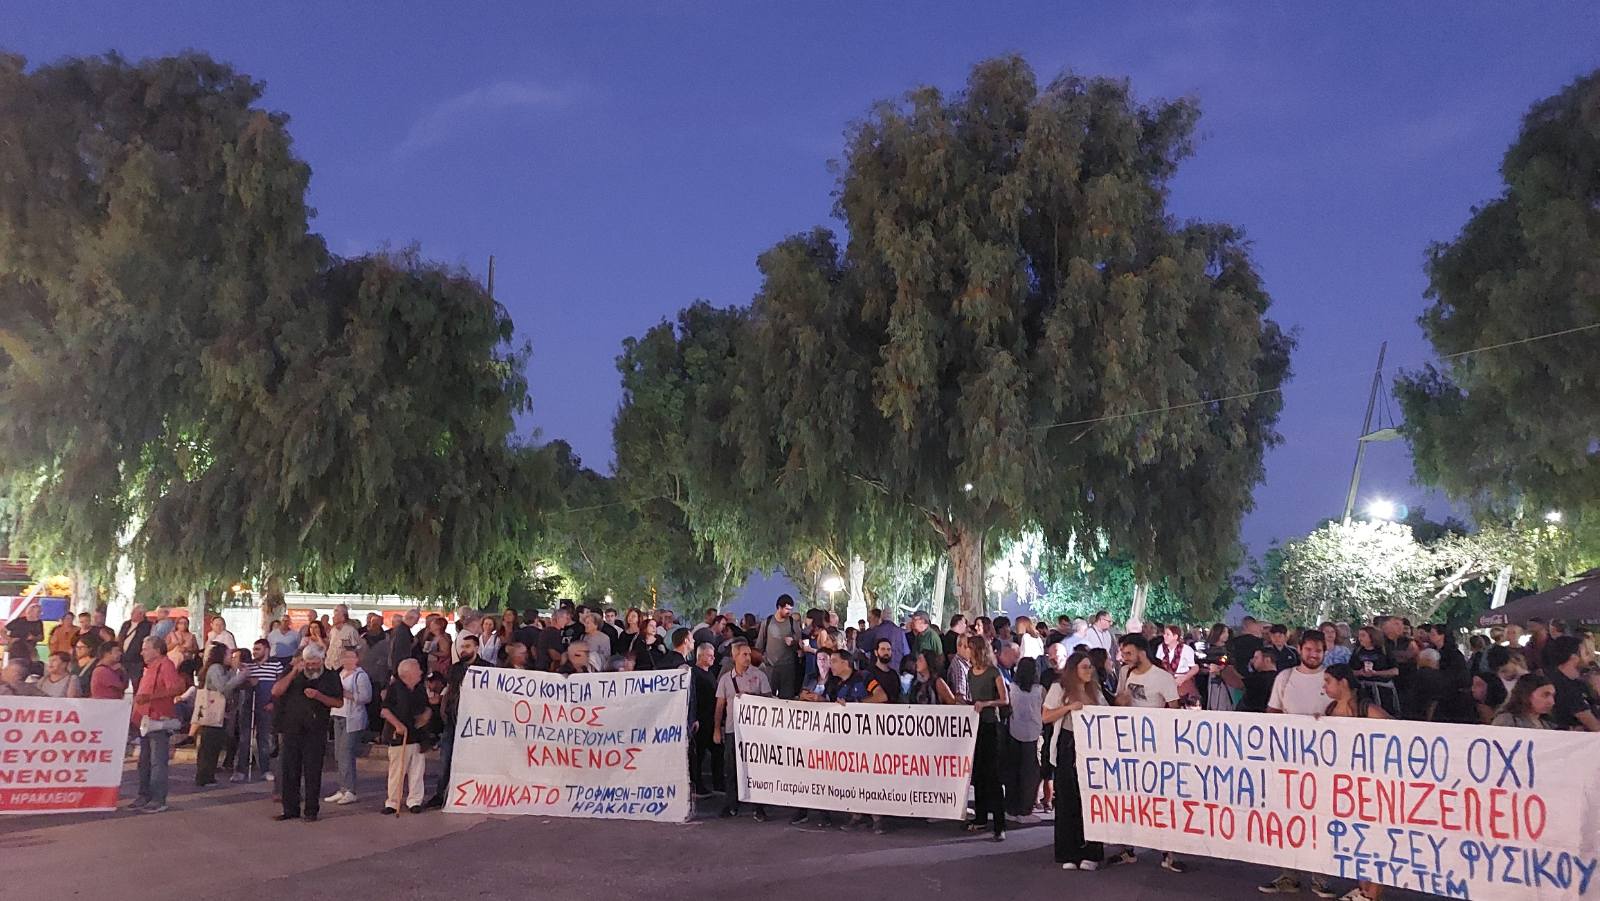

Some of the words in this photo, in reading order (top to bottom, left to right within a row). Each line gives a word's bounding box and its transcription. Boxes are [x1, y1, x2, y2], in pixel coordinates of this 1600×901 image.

[469, 669, 489, 690] ΤΑ
[497, 672, 592, 703] ΝΟΣΟΚΟΜΕΙΑ
[599, 680, 617, 698] ΤΑ
[514, 700, 531, 724] Ο
[542, 703, 606, 726] ΛΑΟΣ
[738, 703, 768, 726] ΚΑΤΩ
[771, 707, 784, 728] ΤΑ
[787, 708, 820, 732] ΧΕΡΙΑ
[823, 711, 851, 734] ΑΠΟ
[855, 714, 872, 735] ΤΑ
[875, 714, 973, 738] ΝΟΣΟΚΟΜΕΙΑ
[4, 729, 23, 743] Ο
[32, 729, 103, 743] ΛΑΟΣ
[460, 716, 497, 738] ΔΕΝ
[501, 720, 517, 738] ΤΑ
[525, 724, 625, 746] ΠΑΖΑΡΕΥΟΥΜΕ
[631, 727, 647, 744] ΓΙΑ
[652, 725, 682, 744] ΧΑΡΗ
[0, 749, 113, 763] ΕΥΟΥΜΕ
[527, 744, 642, 769] ΚΑΝΕΝΟΣ
[786, 746, 805, 768] ΓΙΑ
[807, 748, 869, 774] ΔΗΜΟΣΙΑ
[873, 752, 930, 777] ΔΩΡΕΑΝ
[934, 755, 971, 778] ΥΓΕΙΑ
[1080, 714, 1157, 754] ΥΓΕΙΑ
[1174, 718, 1337, 767] ΚΟΙΝΩΝΙΚΟ
[1467, 738, 1535, 789] ΟΧΙ
[454, 780, 560, 807] ΣΥΝΔΙΚΑΤΟ
[746, 776, 774, 793] Ένωση
[776, 780, 809, 795] Γιατρών
[811, 783, 826, 796] ΕΣΥ
[828, 785, 856, 799] Νομού
[858, 787, 907, 802] Ηρακλείου
[909, 790, 957, 807] (ΕΓΕΣΥΝΗ)
[1086, 757, 1266, 808] ΕΜΠΟΡΕΥΜΑ!
[1278, 768, 1318, 810] ΤΟ
[571, 801, 668, 816] ΗΡΑΚΛΕΙΟΥ
[1247, 809, 1318, 849] ΛΑΟ!
[1387, 828, 1448, 873] ΣΕΥ
[1460, 840, 1598, 896] ΦΥΣΙΚΟΥ
